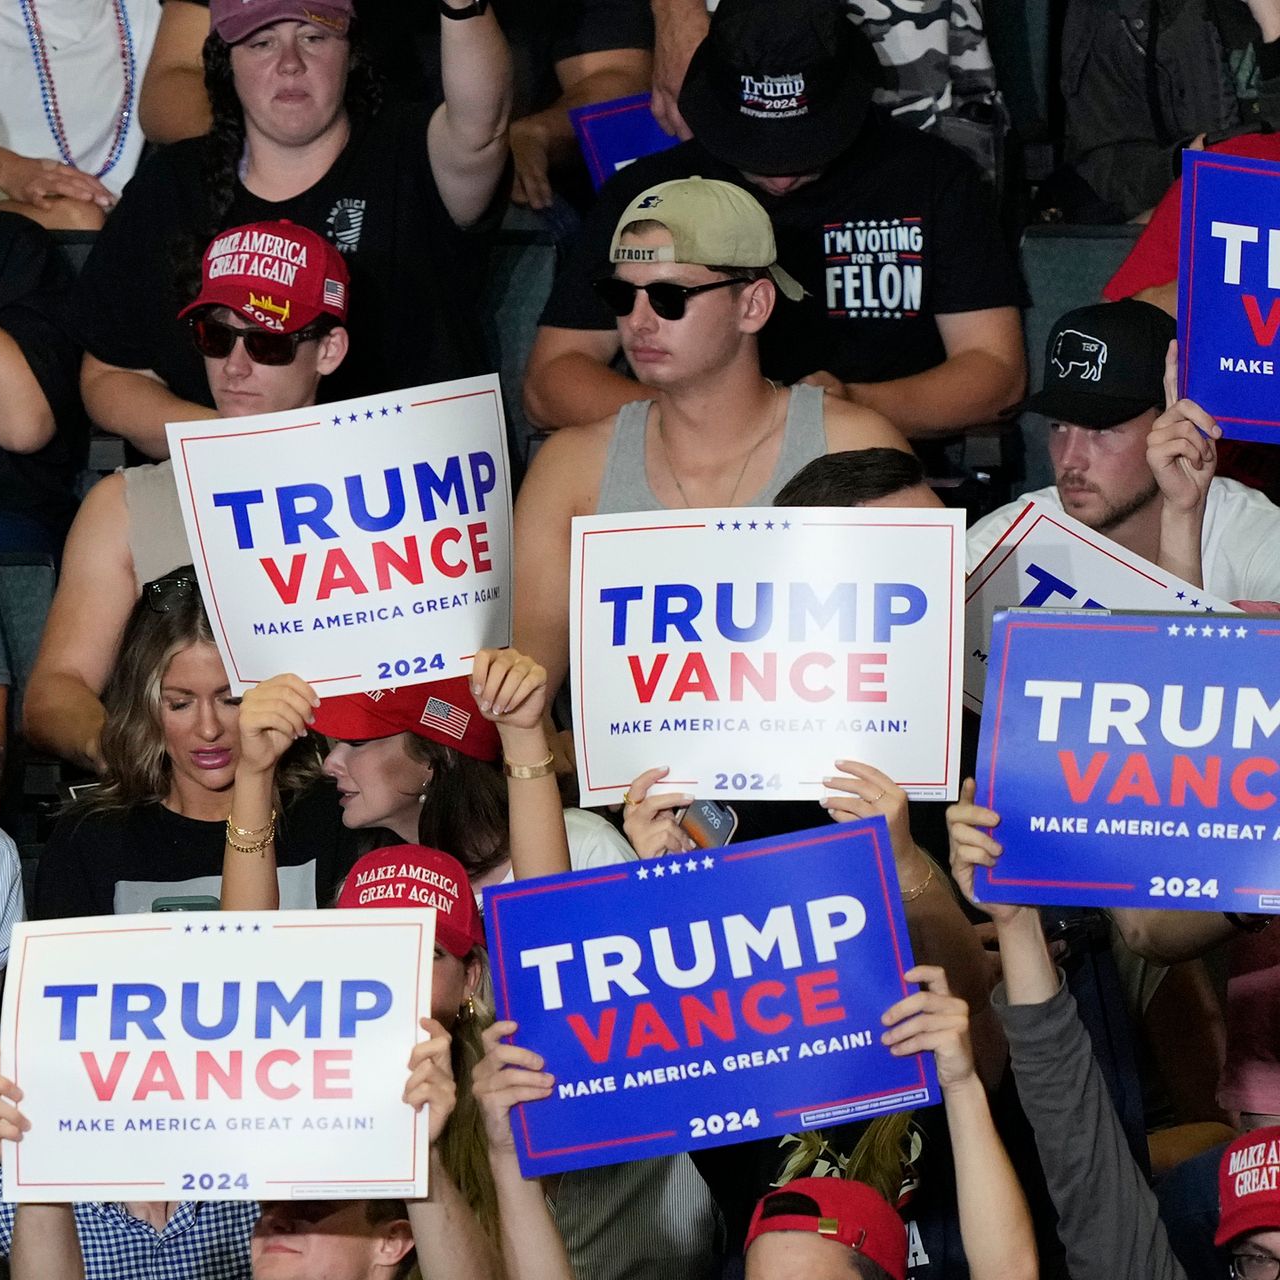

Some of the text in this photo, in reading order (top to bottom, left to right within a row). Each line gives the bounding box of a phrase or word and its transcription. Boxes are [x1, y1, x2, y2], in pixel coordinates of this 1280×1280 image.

[741, 75, 805, 97] Trump
[765, 97, 798, 110] 2024
[207, 231, 308, 268] MAKE AMERICA
[855, 226, 923, 252] VOTING
[208, 254, 299, 287] GREAT AGAIN
[851, 251, 899, 265] FOR THE
[826, 265, 923, 311] FELON
[242, 303, 284, 331] 2024
[213, 451, 496, 549] TRUMP
[259, 522, 493, 614] VANCE
[600, 583, 927, 646] TRUMP
[378, 654, 445, 679] 2024
[628, 652, 886, 703] VANCE
[713, 772, 783, 792] 2024
[356, 864, 458, 903] MAKE AMERICA
[359, 884, 455, 915] GREAT AGAIN
[1150, 877, 1218, 898] 2024
[521, 895, 866, 1010] TRUMP
[43, 980, 392, 1040] TRUMP
[569, 972, 844, 1061] VANCE
[80, 1049, 352, 1101] VANCE
[559, 1031, 872, 1099] MAKE AMERICA GREAT AGAIN!
[690, 1108, 760, 1137] 2024
[1229, 1142, 1267, 1176] MAKE
[182, 1174, 248, 1190] 2024
[1235, 1165, 1280, 1199] GREAT
